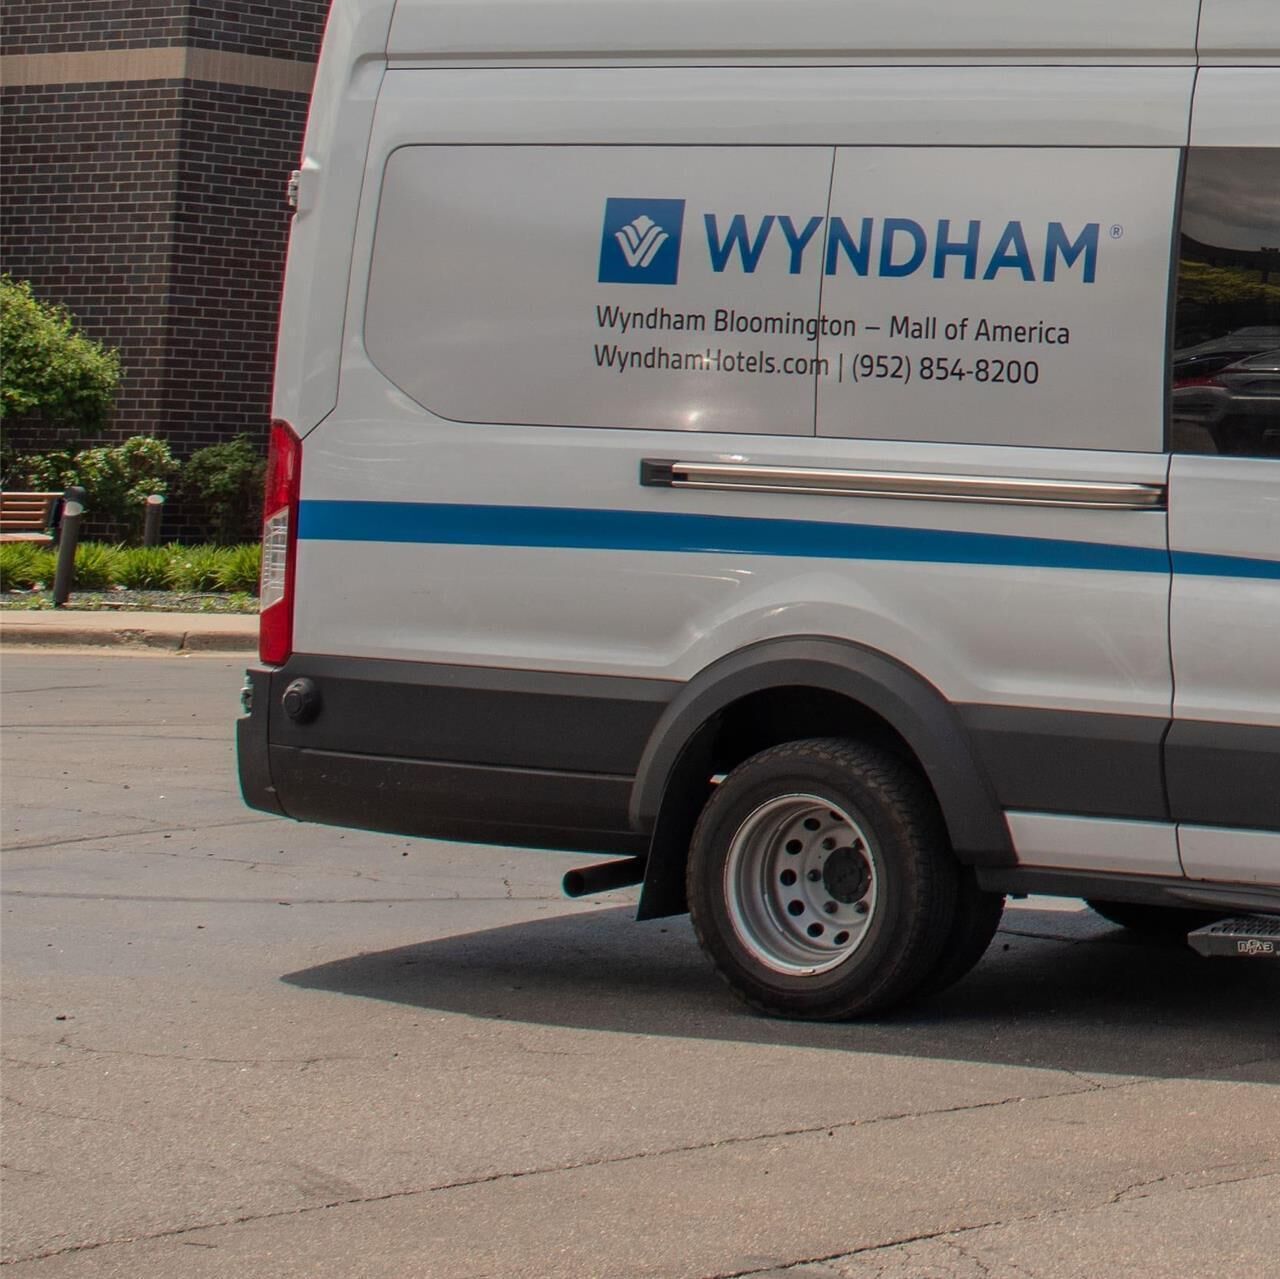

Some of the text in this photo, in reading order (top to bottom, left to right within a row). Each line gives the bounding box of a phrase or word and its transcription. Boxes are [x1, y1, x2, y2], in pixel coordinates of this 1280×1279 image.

[596, 305, 706, 334] Wyndham
[714, 309, 857, 341] Bloomington
[889, 315, 937, 340] Mall
[944, 318, 969, 341] of
[974, 318, 1070, 345] America
[594, 344, 830, 376] WyndhamHotels.com
[852, 353, 912, 385] (952)
[919, 356, 1040, 385] 854-8200
